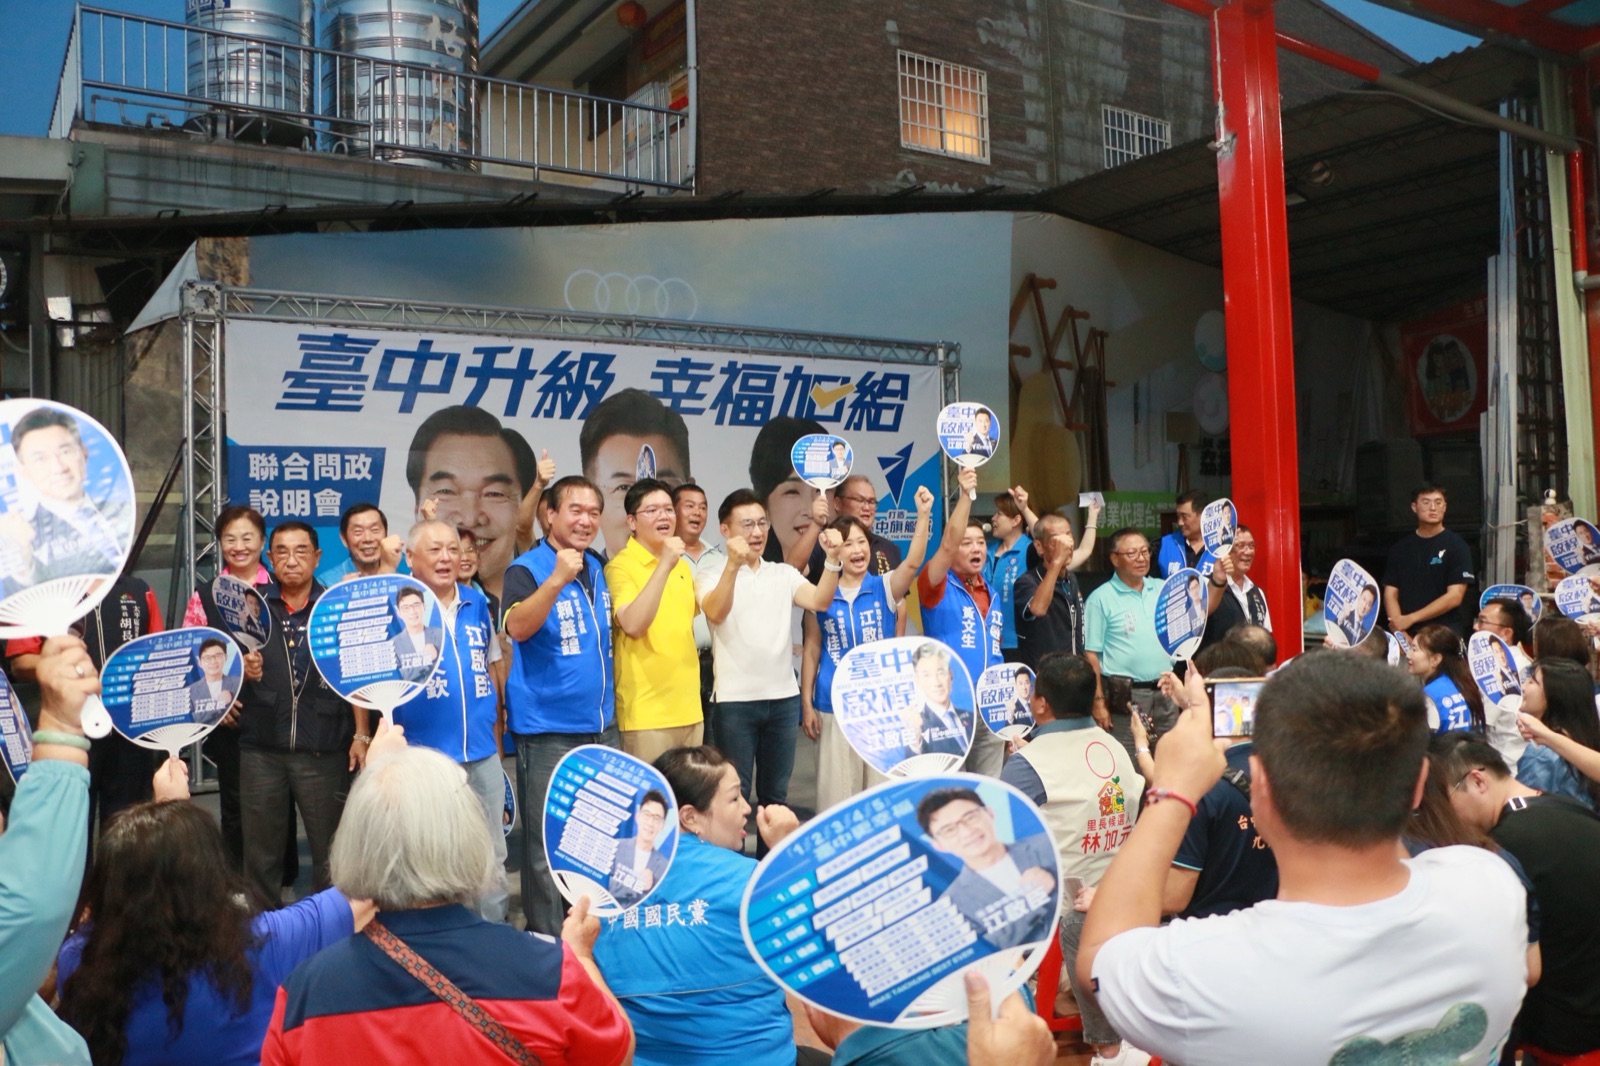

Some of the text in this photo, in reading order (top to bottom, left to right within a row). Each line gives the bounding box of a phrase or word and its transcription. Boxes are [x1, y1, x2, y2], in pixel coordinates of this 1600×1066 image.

[275, 333, 910, 432] 臺中升級 幸福加給
[249, 452, 372, 481] 聯合問政
[249, 488, 343, 517] 說明會
[961, 606, 976, 649] 黃文生
[465, 624, 488, 698] 江啟臣
[848, 647, 911, 681] 臺中
[842, 682, 915, 719] 啟程
[1448, 705, 1469, 731] 江
[1087, 811, 1131, 831] 里長候選人
[1081, 825, 1132, 854] 林加元
